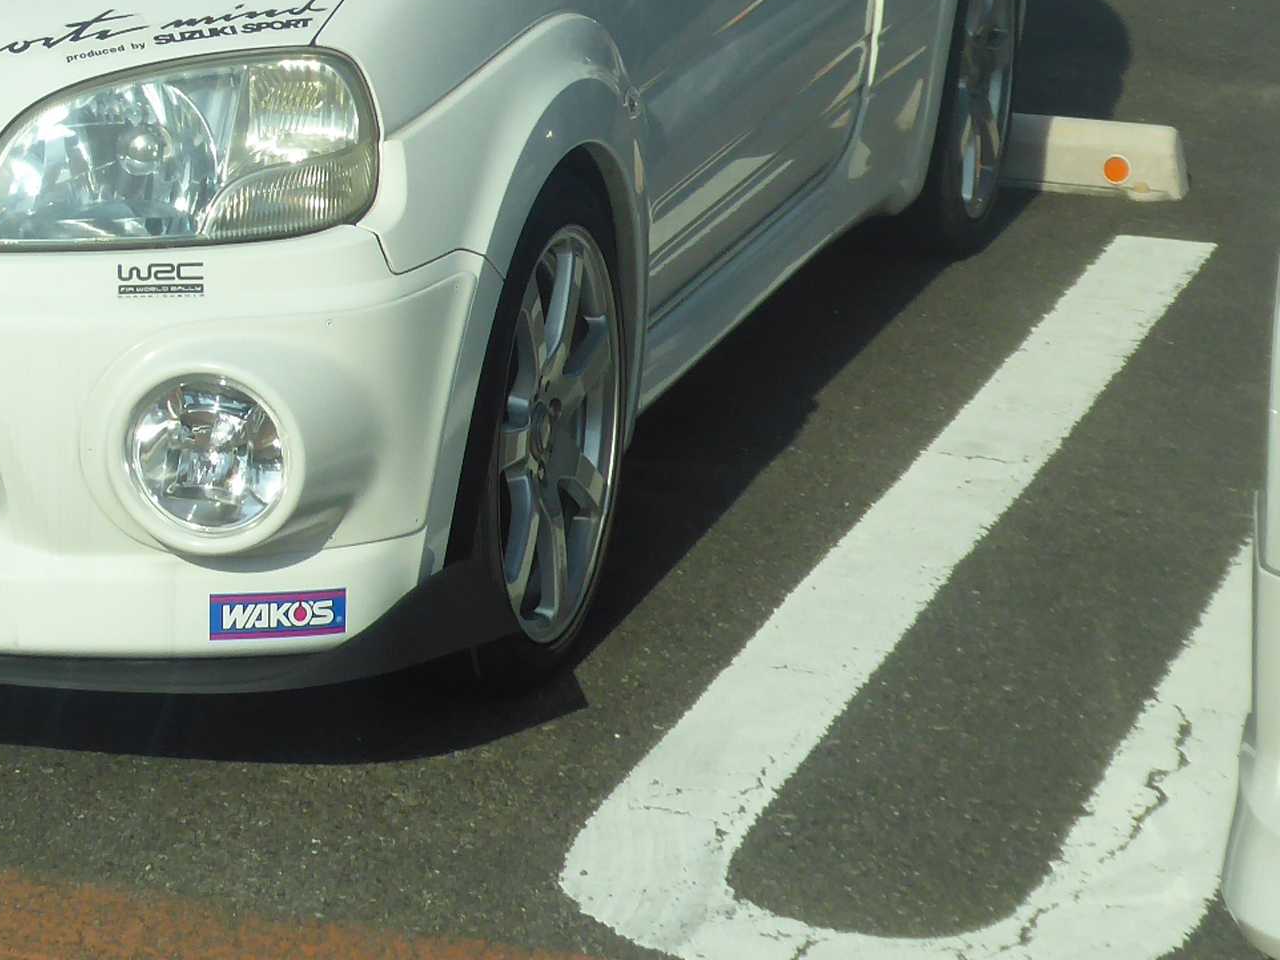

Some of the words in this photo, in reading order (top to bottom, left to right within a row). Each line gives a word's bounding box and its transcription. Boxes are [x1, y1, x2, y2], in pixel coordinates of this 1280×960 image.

[65, 43, 126, 64] produced
[131, 41, 146, 53] by
[153, 24, 238, 45] SUZUKI
[240, 17, 314, 34] SPORT
[117, 262, 204, 281] WRC
